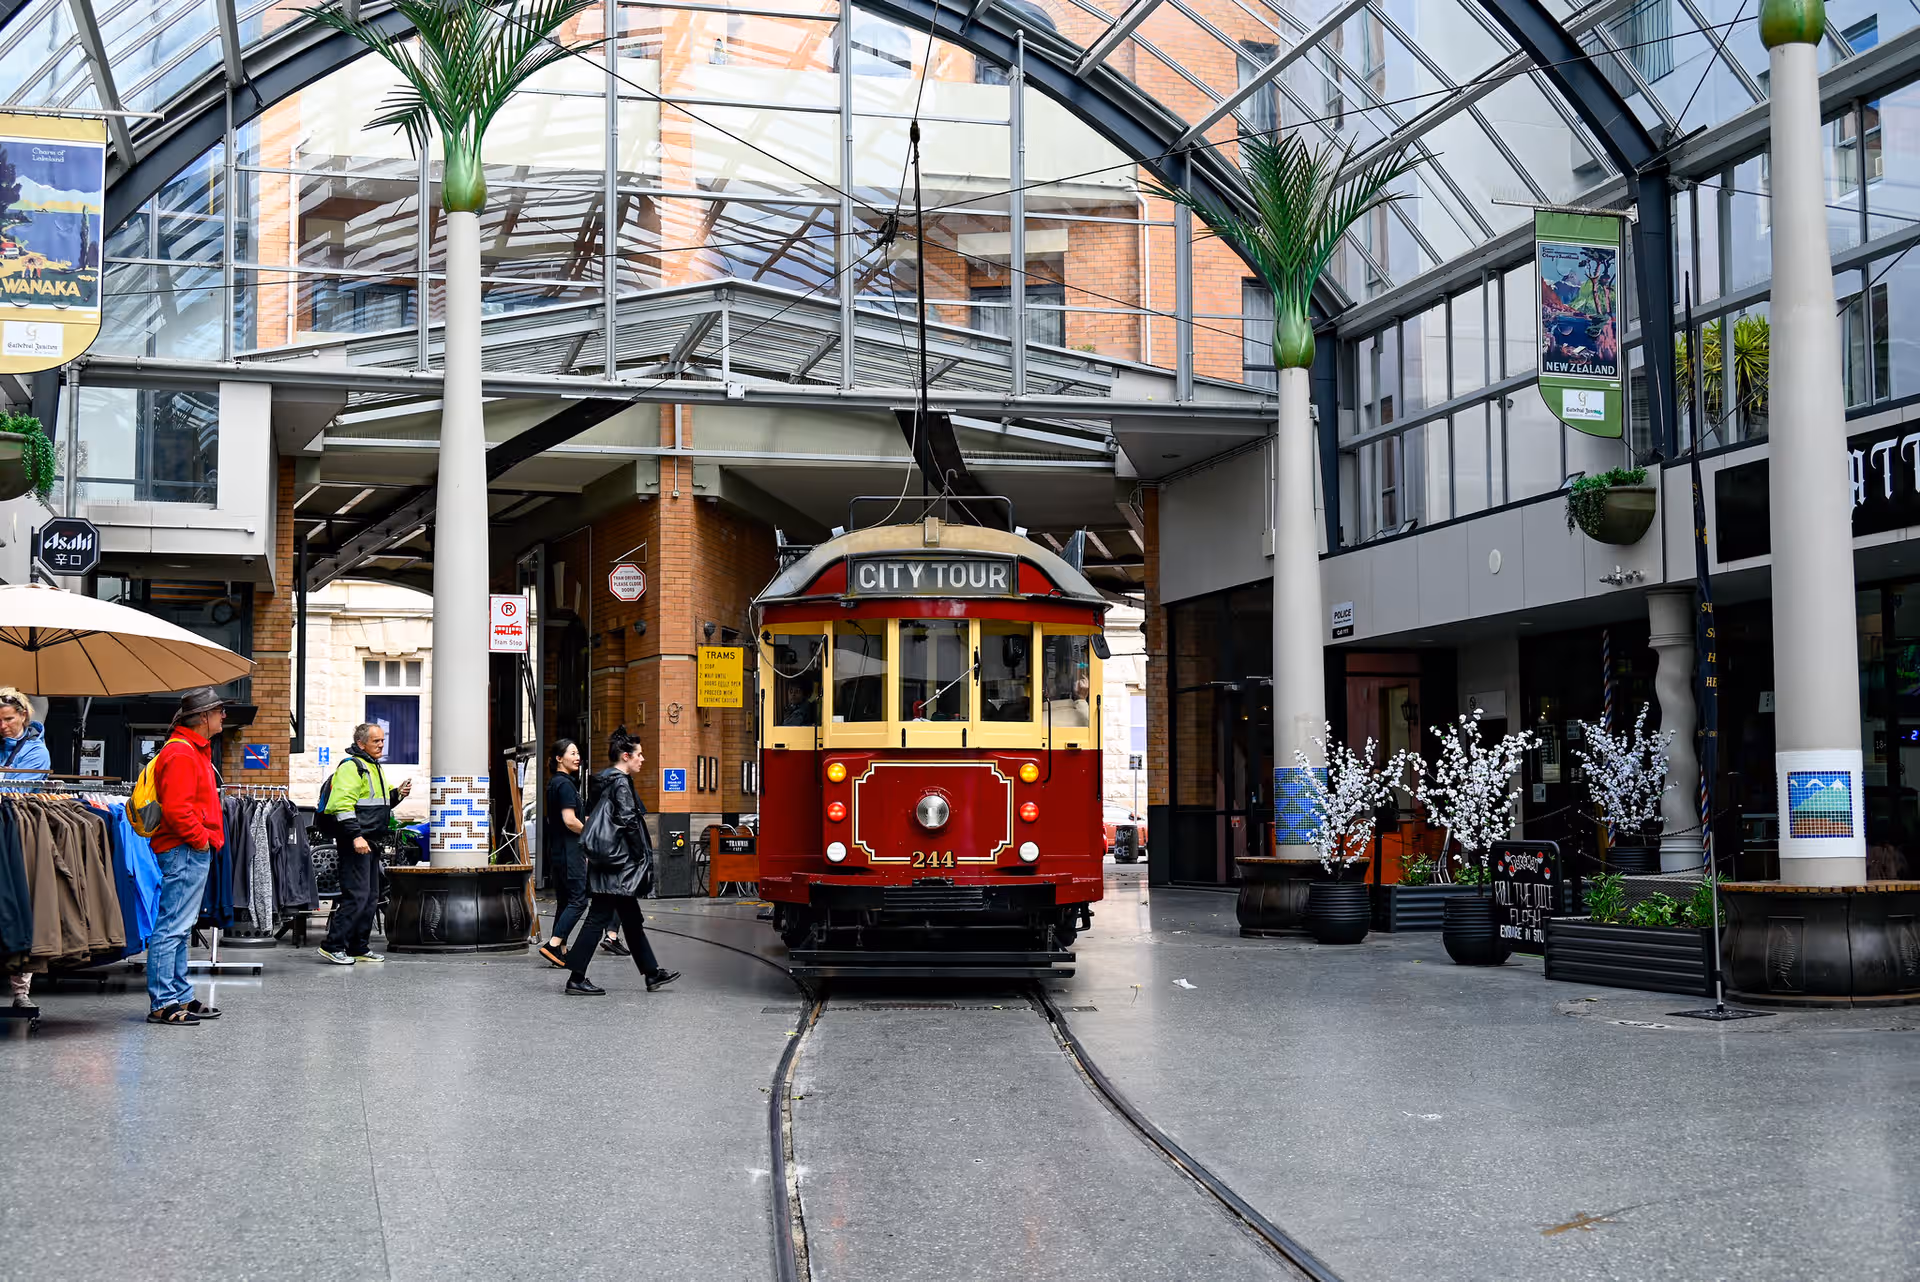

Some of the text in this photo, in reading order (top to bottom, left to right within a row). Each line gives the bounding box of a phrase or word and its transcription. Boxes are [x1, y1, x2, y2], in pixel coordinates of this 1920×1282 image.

[32, 147, 55, 155] Charm
[2, 278, 81, 297] WANAKA
[1546, 361, 1615, 375] NEW ZEALAND
[44, 532, 92, 551] Asahi
[55, 553, 81, 566] 辛口
[859, 562, 1006, 589] CITY TOUR
[1334, 608, 1351, 620] POLICE
[706, 651, 735, 660] TRAMS
[912, 850, 955, 868] 244
